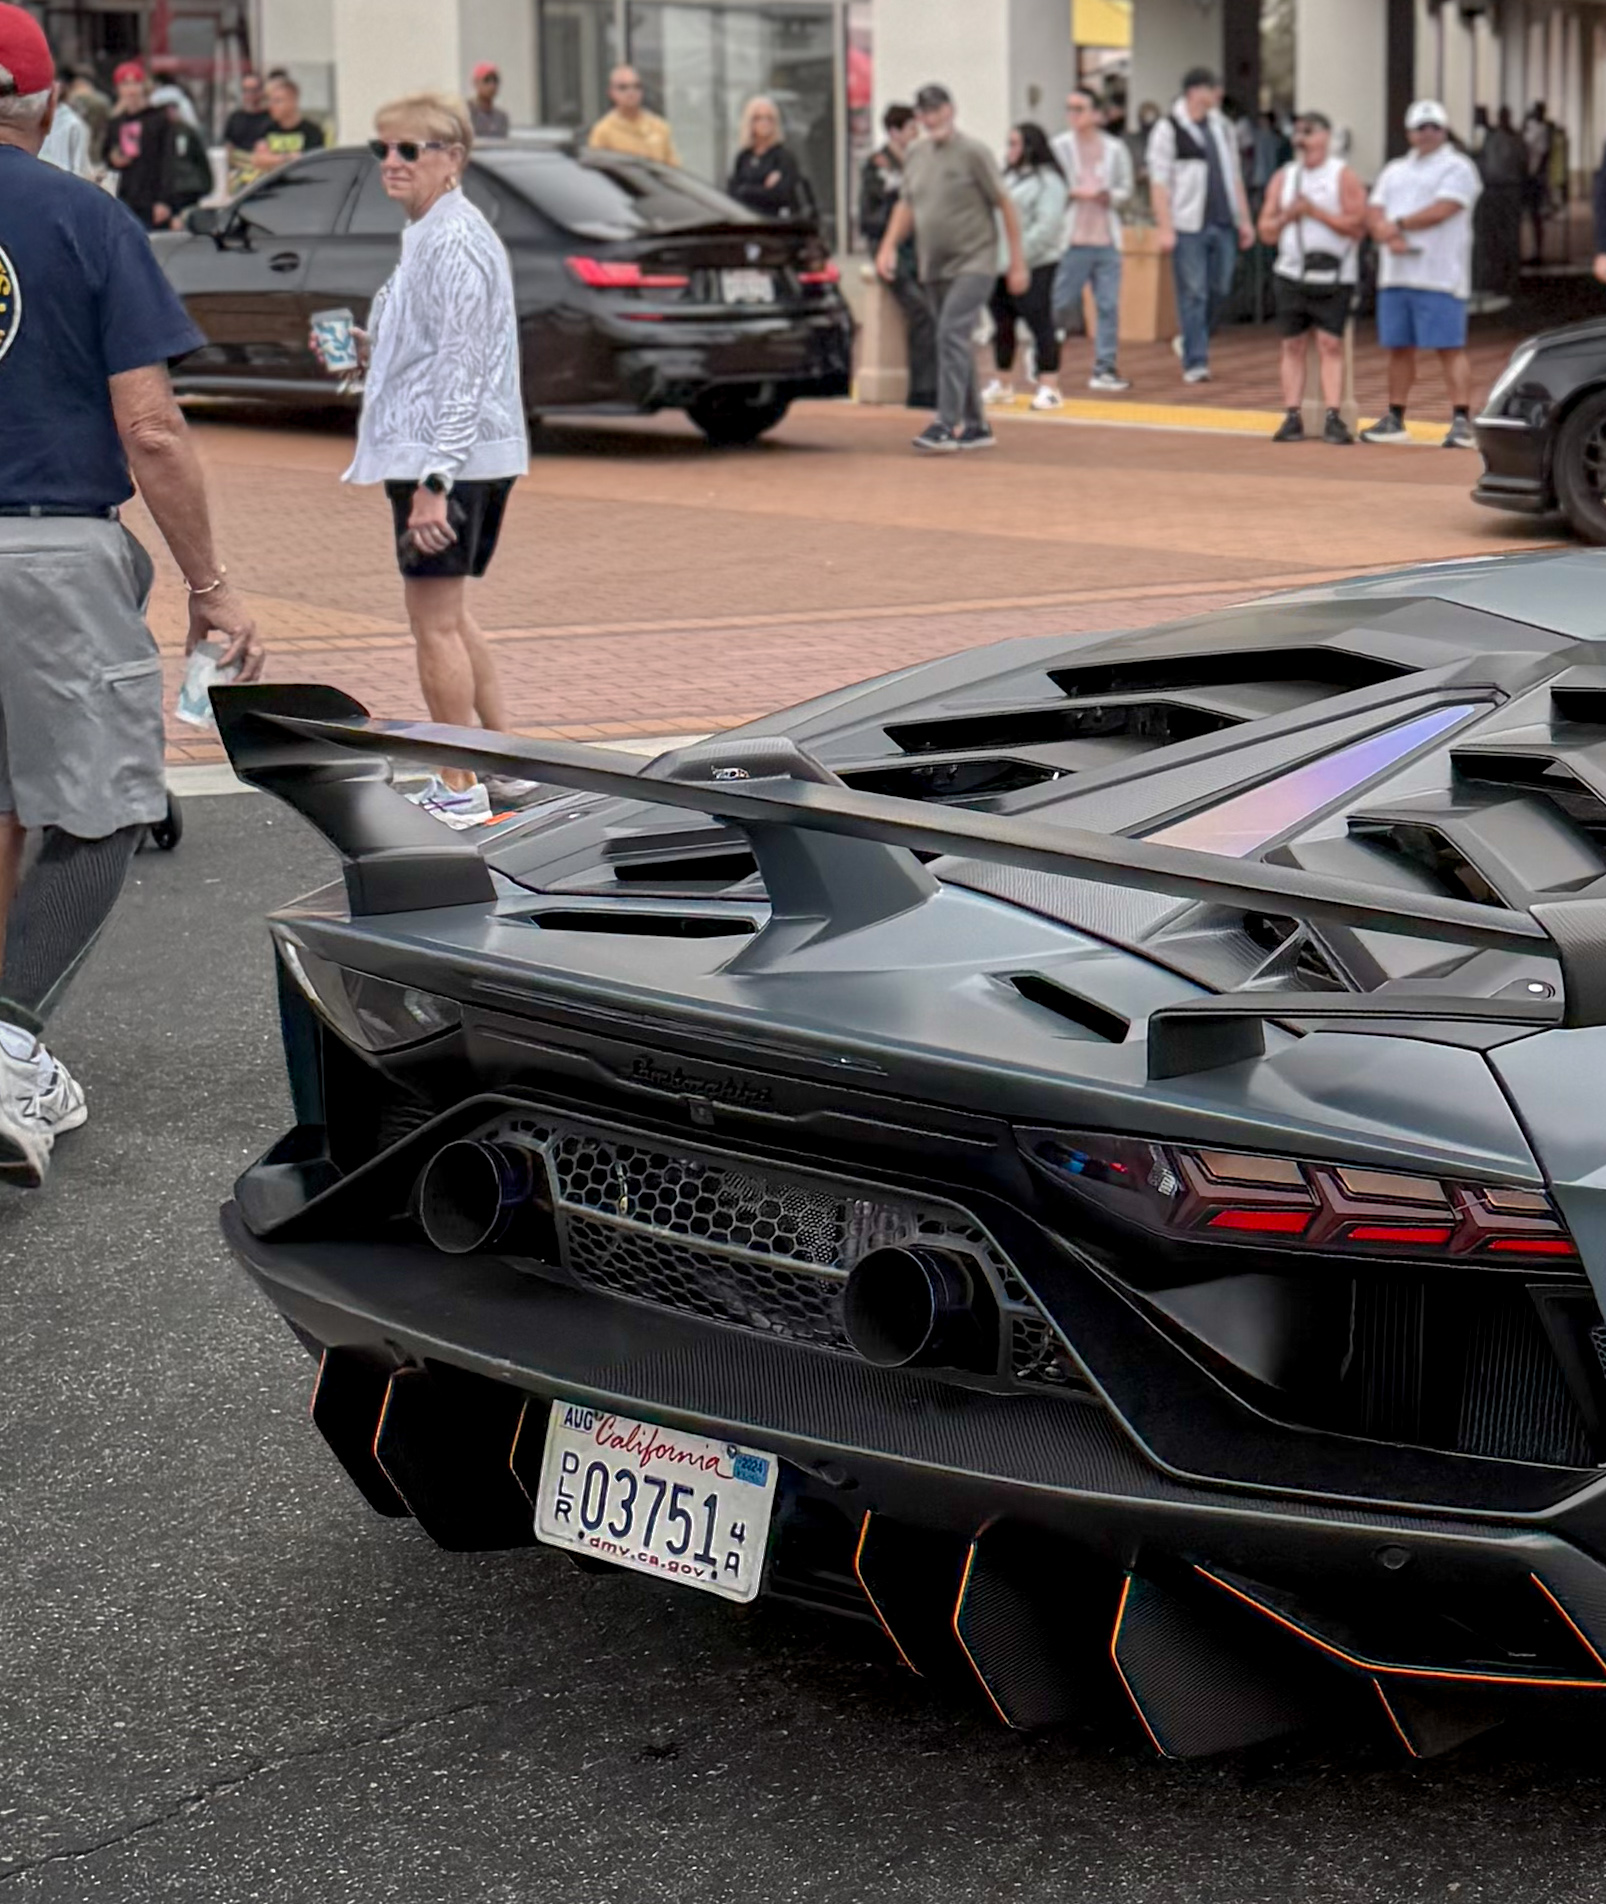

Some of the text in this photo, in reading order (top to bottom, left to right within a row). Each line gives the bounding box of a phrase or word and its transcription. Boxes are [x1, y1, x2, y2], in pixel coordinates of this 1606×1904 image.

[564, 1406, 593, 1431] AUG
[595, 1414, 734, 1479] California
[581, 1460, 719, 1567] 03751
[589, 1536, 706, 1578] dmv.ca.gov
